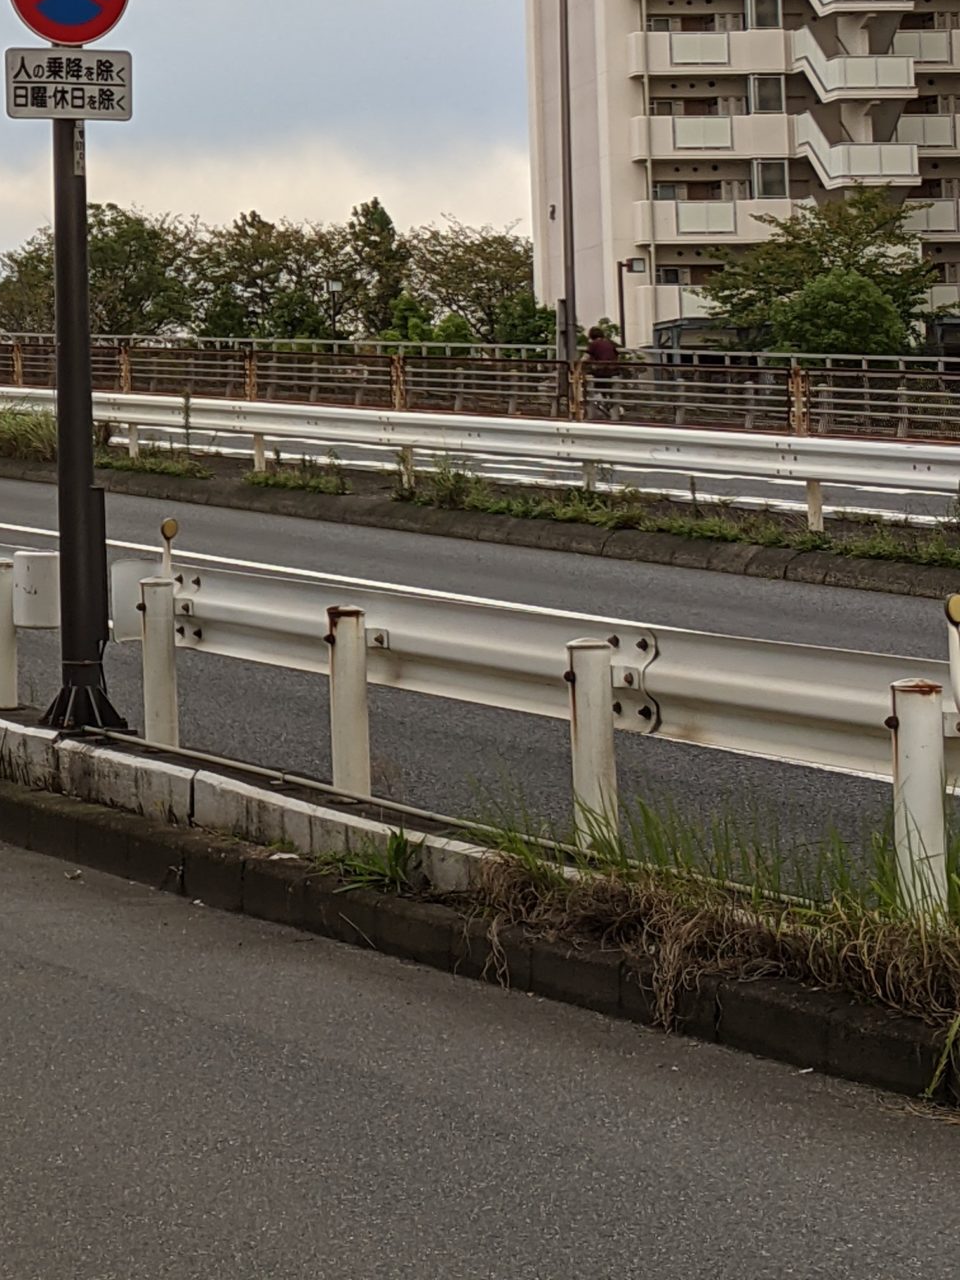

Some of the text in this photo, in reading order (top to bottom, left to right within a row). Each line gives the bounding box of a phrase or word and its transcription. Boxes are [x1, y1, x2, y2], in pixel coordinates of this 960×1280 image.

[13, 56, 126, 83] 人の乗降を除く
